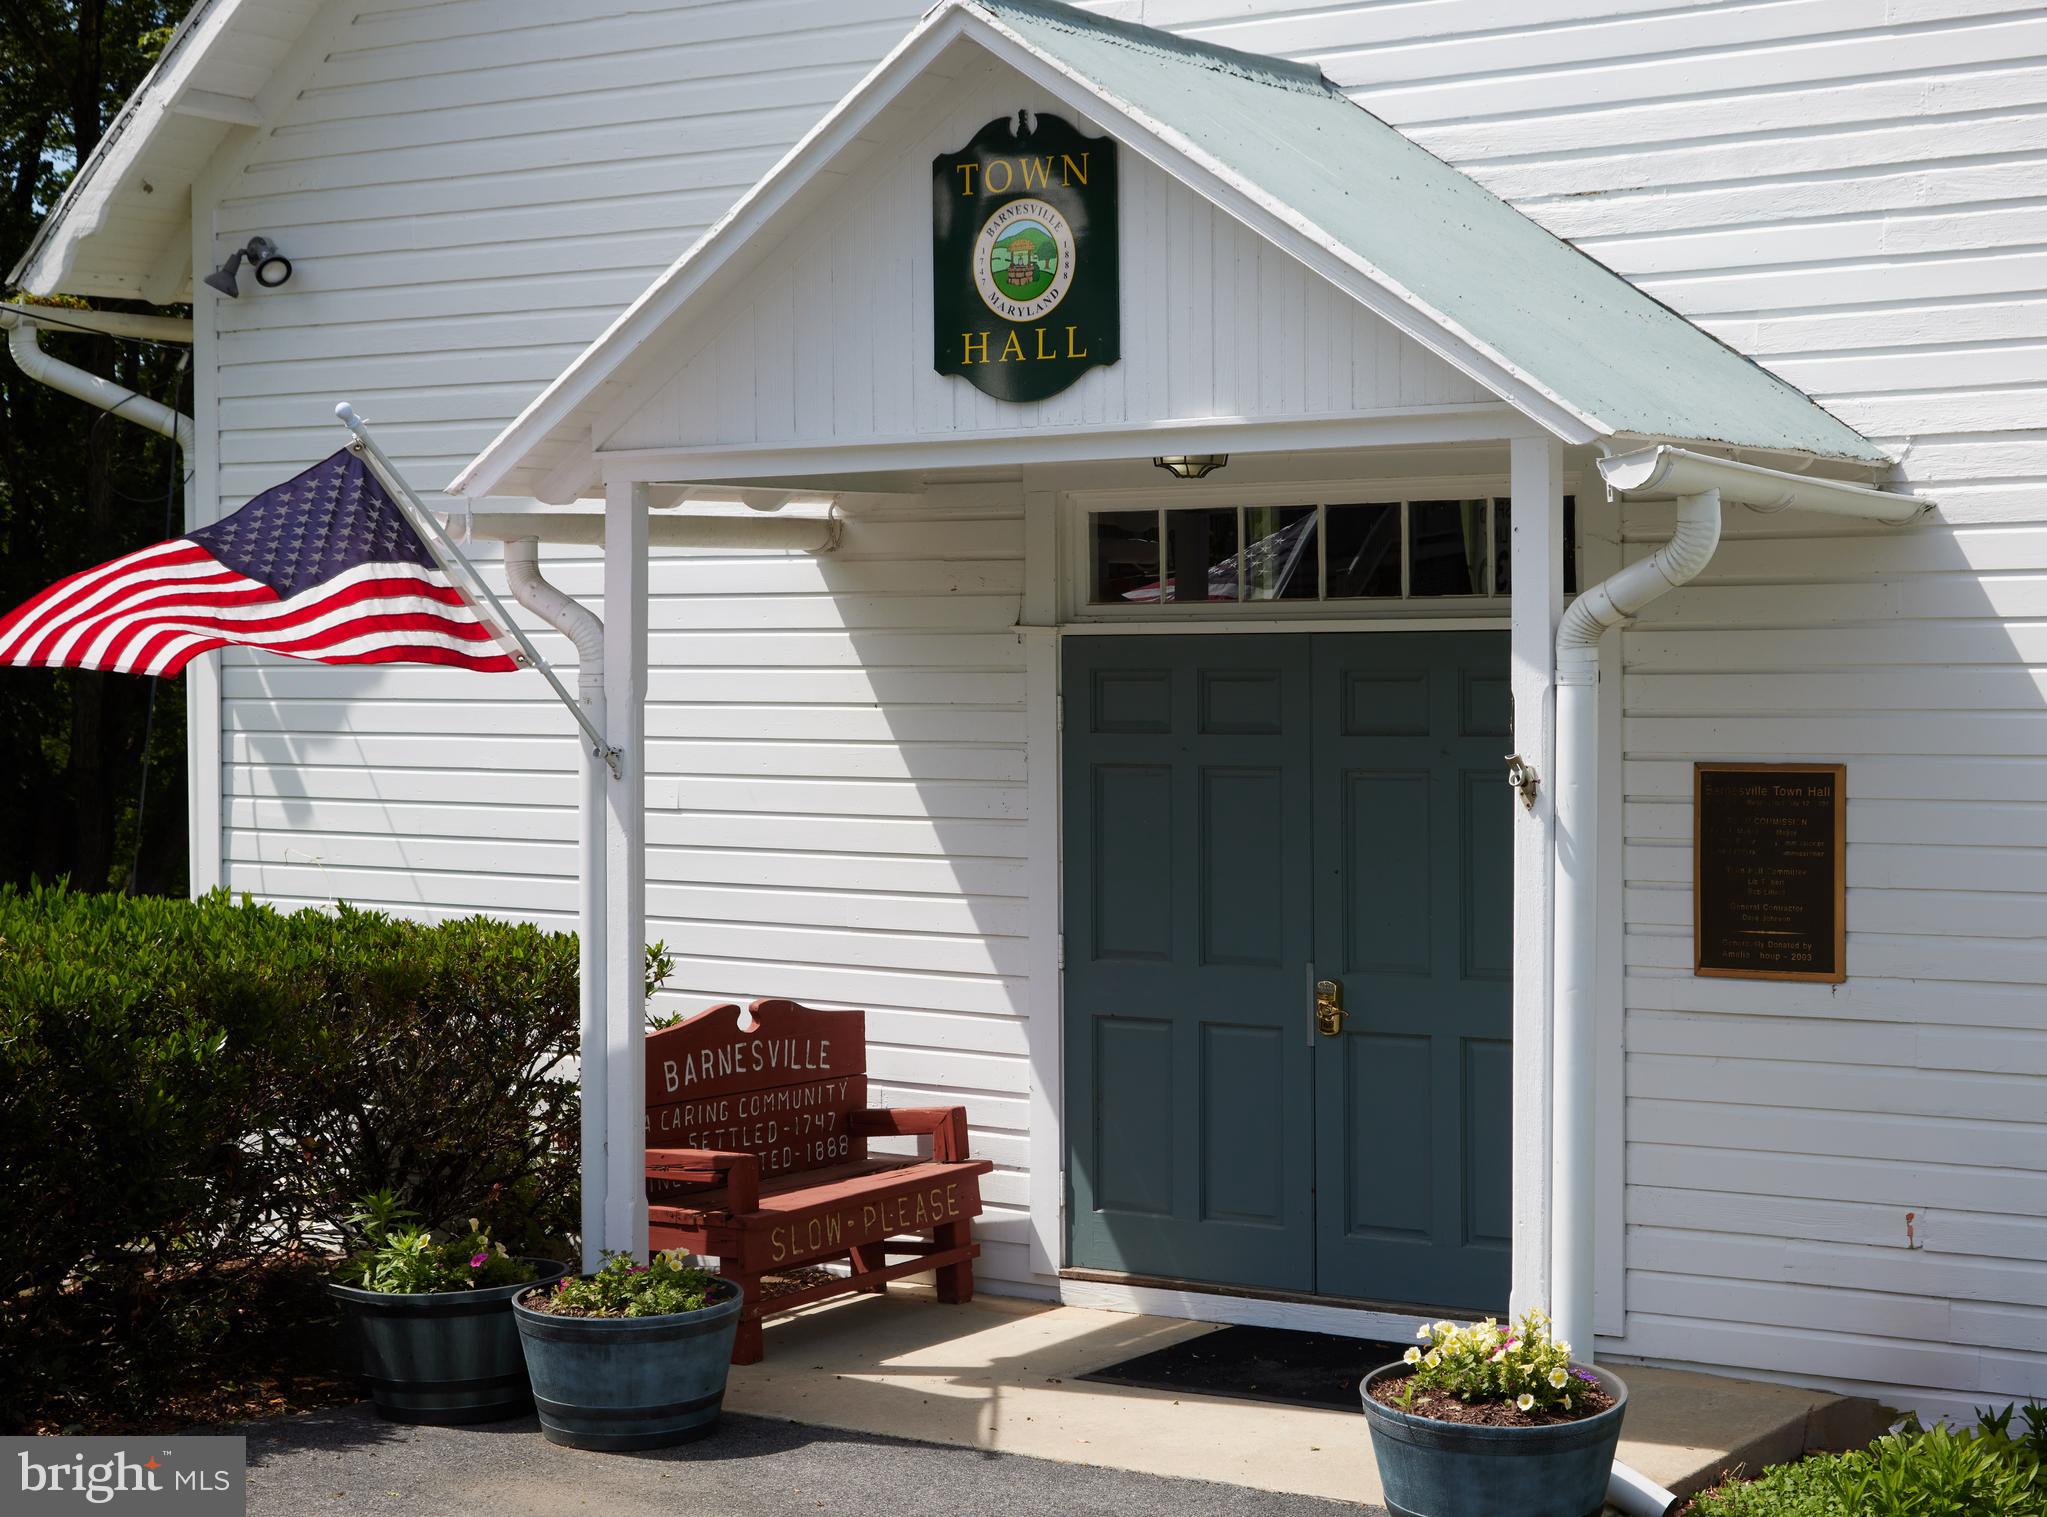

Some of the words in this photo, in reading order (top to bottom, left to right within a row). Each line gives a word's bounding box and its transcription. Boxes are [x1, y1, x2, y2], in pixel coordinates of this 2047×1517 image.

[956, 152, 1090, 196] TOWN
[986, 203, 1063, 238] BARNESVILLE
[988, 287, 1060, 317] MARYLAND
[961, 326, 1087, 365] HALL
[1773, 785, 1802, 797] Town
[1808, 786, 1831, 798] Hall
[1759, 951, 1781, 961] houp
[663, 1039, 831, 1093] BARNESVILLE
[661, 1101, 728, 1131] CARING
[739, 1079, 849, 1118] COMMUNITY
[863, 1184, 960, 1233] PLEASE
